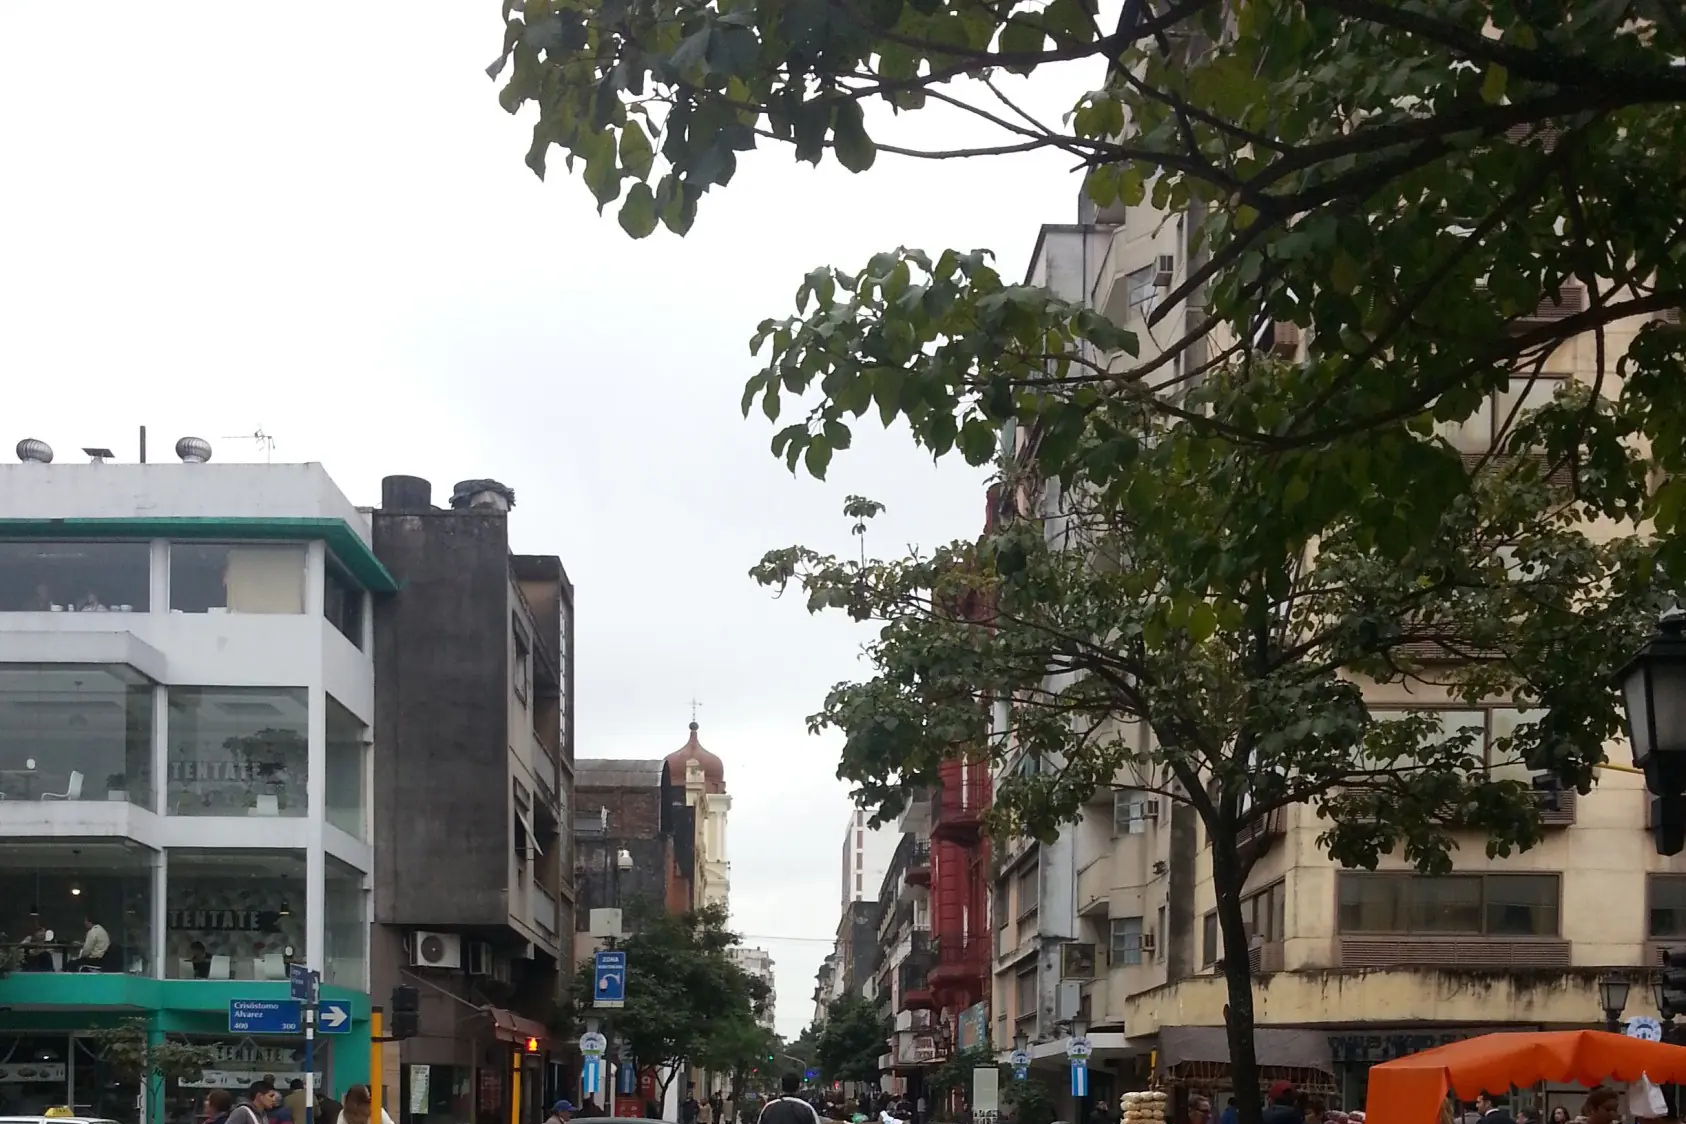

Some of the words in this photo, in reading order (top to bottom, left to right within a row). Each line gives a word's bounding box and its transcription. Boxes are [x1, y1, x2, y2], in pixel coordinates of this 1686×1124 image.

[171, 761, 261, 779] TENTATE
[168, 910, 260, 928] TENTATE
[233, 1022, 249, 1030] 400
[281, 1022, 297, 1030] 300
